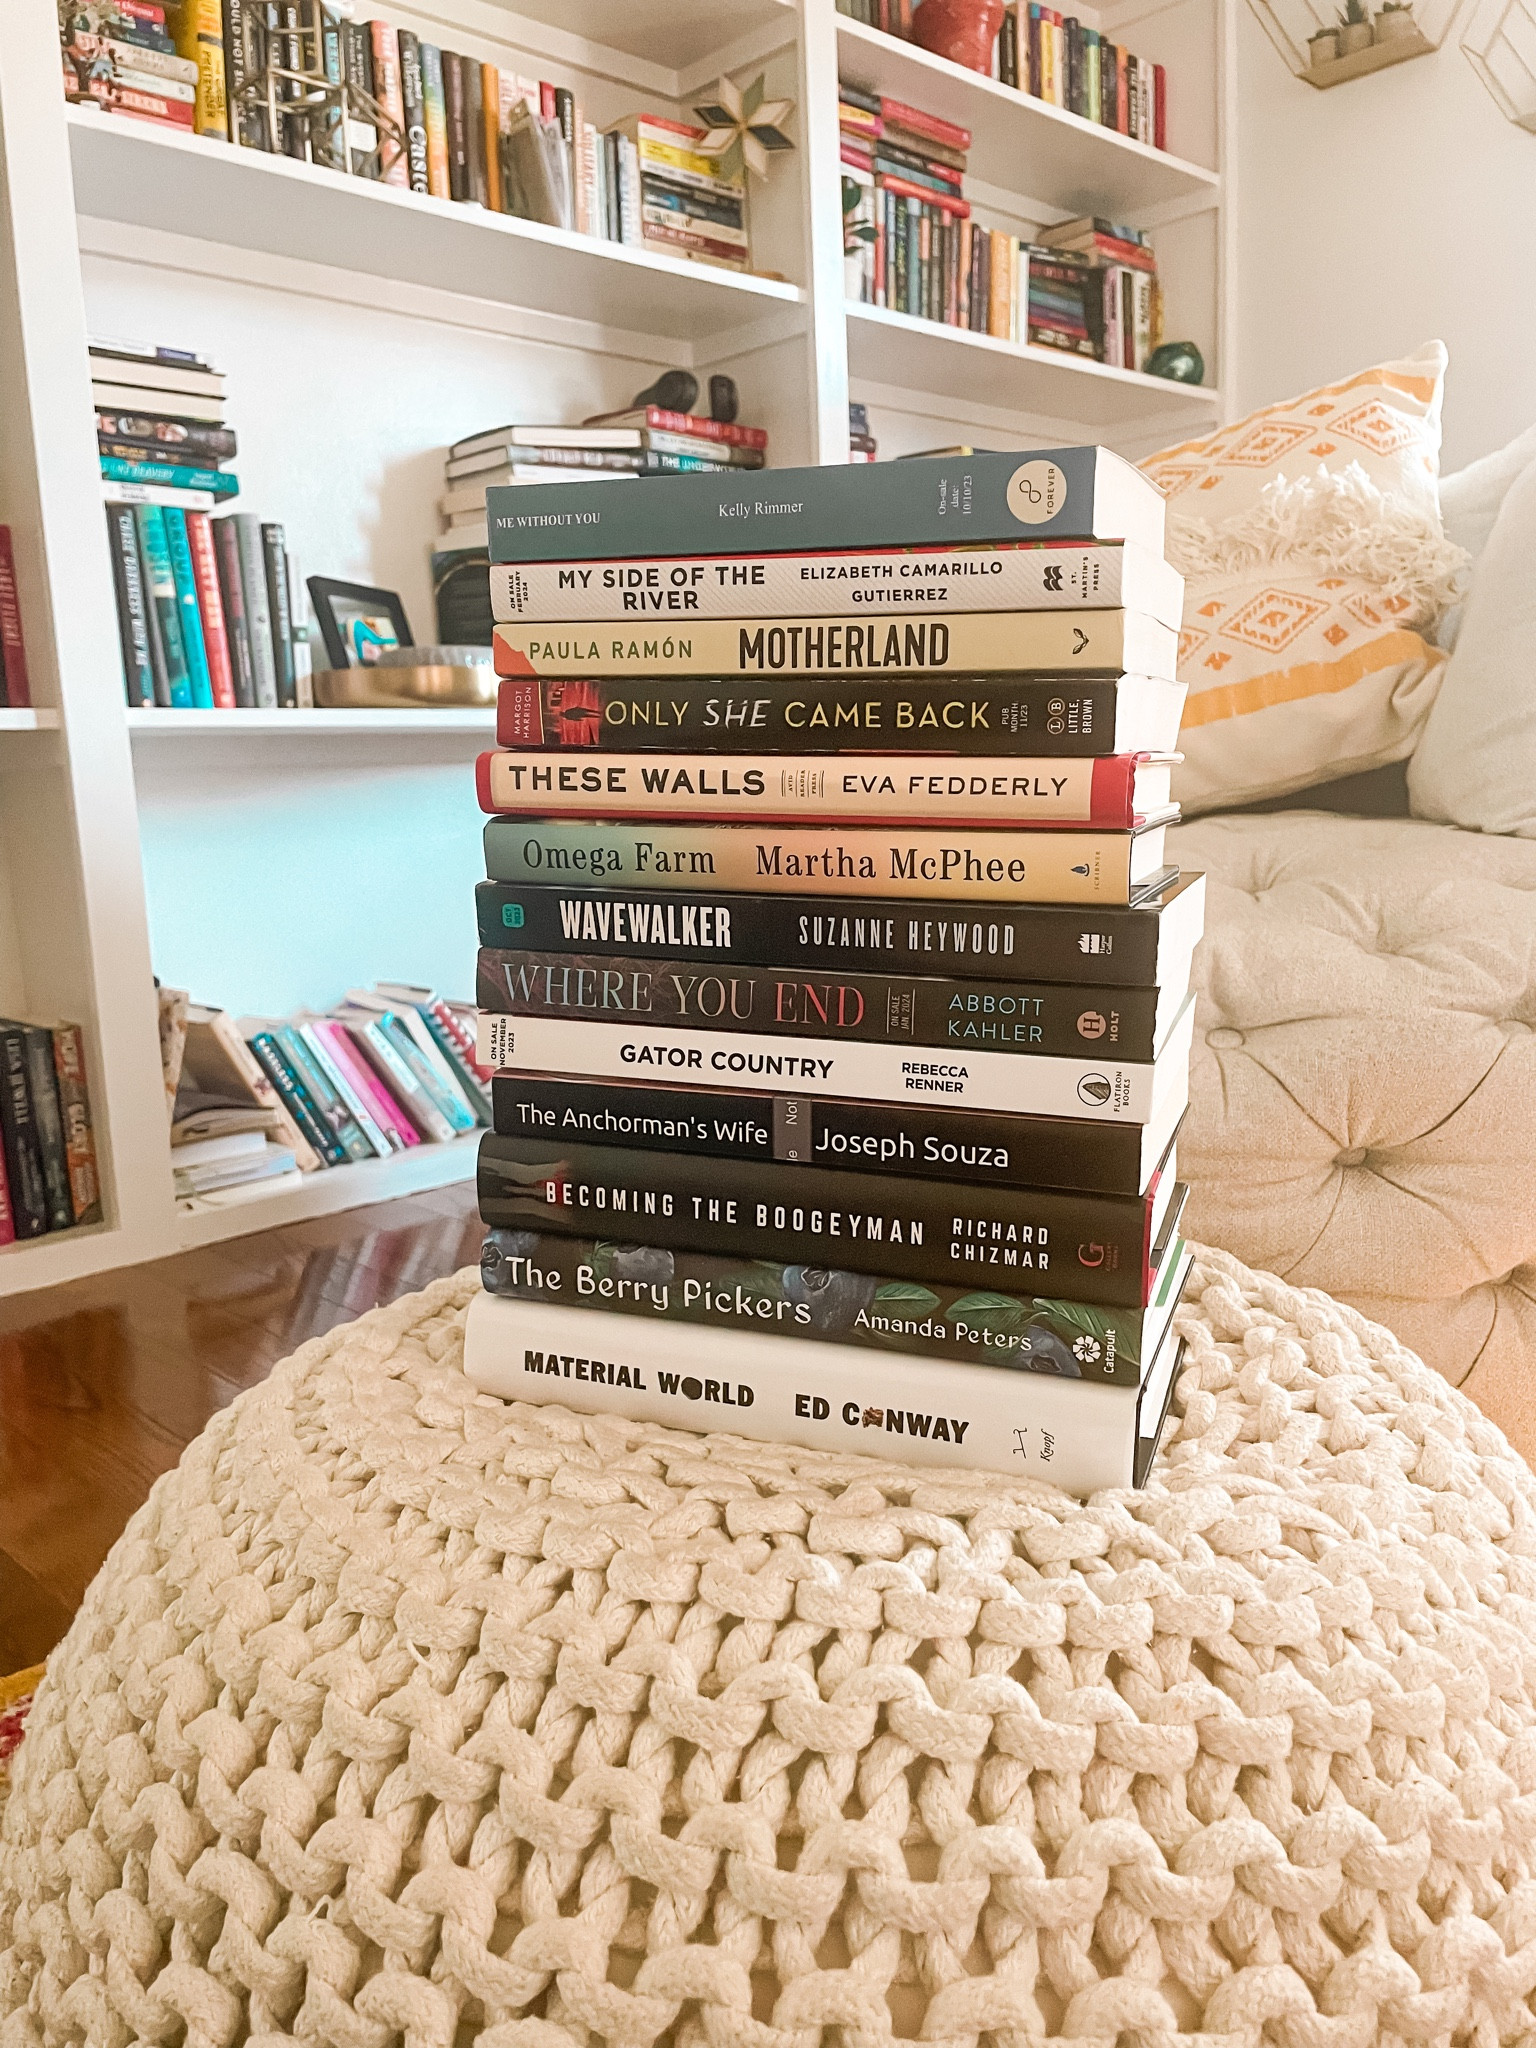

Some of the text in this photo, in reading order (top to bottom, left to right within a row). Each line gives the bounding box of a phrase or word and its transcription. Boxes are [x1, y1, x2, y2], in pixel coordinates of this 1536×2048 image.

[408, 125, 429, 194] Caste
[938, 479, 948, 515] On-sale
[951, 484, 960, 508] date:
[962, 475, 974, 515] 10/10/23
[1046, 467, 1055, 514] FOREVER
[496, 512, 601, 529] ME WITHOUT YOU
[719, 501, 804, 519] Kelly Rimmer
[558, 565, 765, 589] MY SIDE OF THE
[800, 561, 1003, 580] ELIZABETH CAMARILLO
[510, 597, 516, 609] ON
[515, 570, 523, 613] FEBRUARY
[623, 590, 700, 611] RIVER
[852, 588, 948, 602] GUTIERREZ
[529, 636, 692, 660] PAULA RAMÓN
[739, 623, 949, 669] MOTHERLAND
[514, 690, 522, 735] MARGOT
[523, 686, 532, 739] HARRISON
[605, 699, 990, 730] ONLY SHE CAME BACK
[1001, 707, 1009, 725] PUB
[1010, 702, 1019, 733] MONTH
[1020, 704, 1028, 728] 11/23
[1068, 699, 1080, 734] LITTLE,
[1082, 699, 1093, 734] BROWN
[508, 766, 765, 796] THESE WALLS
[843, 775, 1068, 797] EVA FEDDERLY
[522, 839, 716, 877] Omega Farm
[756, 845, 1026, 882] Martha McPhee
[1093, 850, 1101, 890] SCRIBNER
[559, 900, 732, 948] WAVEWALKER
[799, 915, 1015, 955] SUZANNE HEYWOOD
[501, 963, 865, 1027] WHERE YOU END
[890, 995, 900, 1027] ON SALE
[901, 993, 911, 1030] JAN 2024
[948, 993, 1044, 1017] ABBOTT
[499, 1018, 507, 1066] NOVEMBER
[507, 1032, 515, 1053] 2023
[948, 1020, 1043, 1043] KAHLER
[1110, 1010, 1120, 1042] HOLT
[490, 1044, 497, 1060] ON
[620, 1044, 834, 1079] GATOR COUNTRY
[901, 1062, 969, 1078] REBECCA
[905, 1077, 964, 1093] RENNER
[1113, 1070, 1122, 1112] FLATIRON
[1122, 1078, 1131, 1107] BOOKS
[516, 1104, 768, 1144] The Anchorman's Wife
[785, 1101, 798, 1126] Not
[815, 1127, 1009, 1168] Joseph Souza
[546, 1181, 924, 1246] BECOMING THE BOOGEYMAN
[952, 1217, 1049, 1246] RICHARD
[950, 1242, 1050, 1270] CHIZMAR
[505, 1256, 812, 1325] The Berry Pickers
[854, 1308, 1032, 1352] Amanda Peters
[1103, 1328, 1116, 1374] Catapult
[524, 1350, 647, 1391] MATERIAL
[795, 1393, 830, 1420] ED
[1040, 1428, 1055, 1462] Knopf
